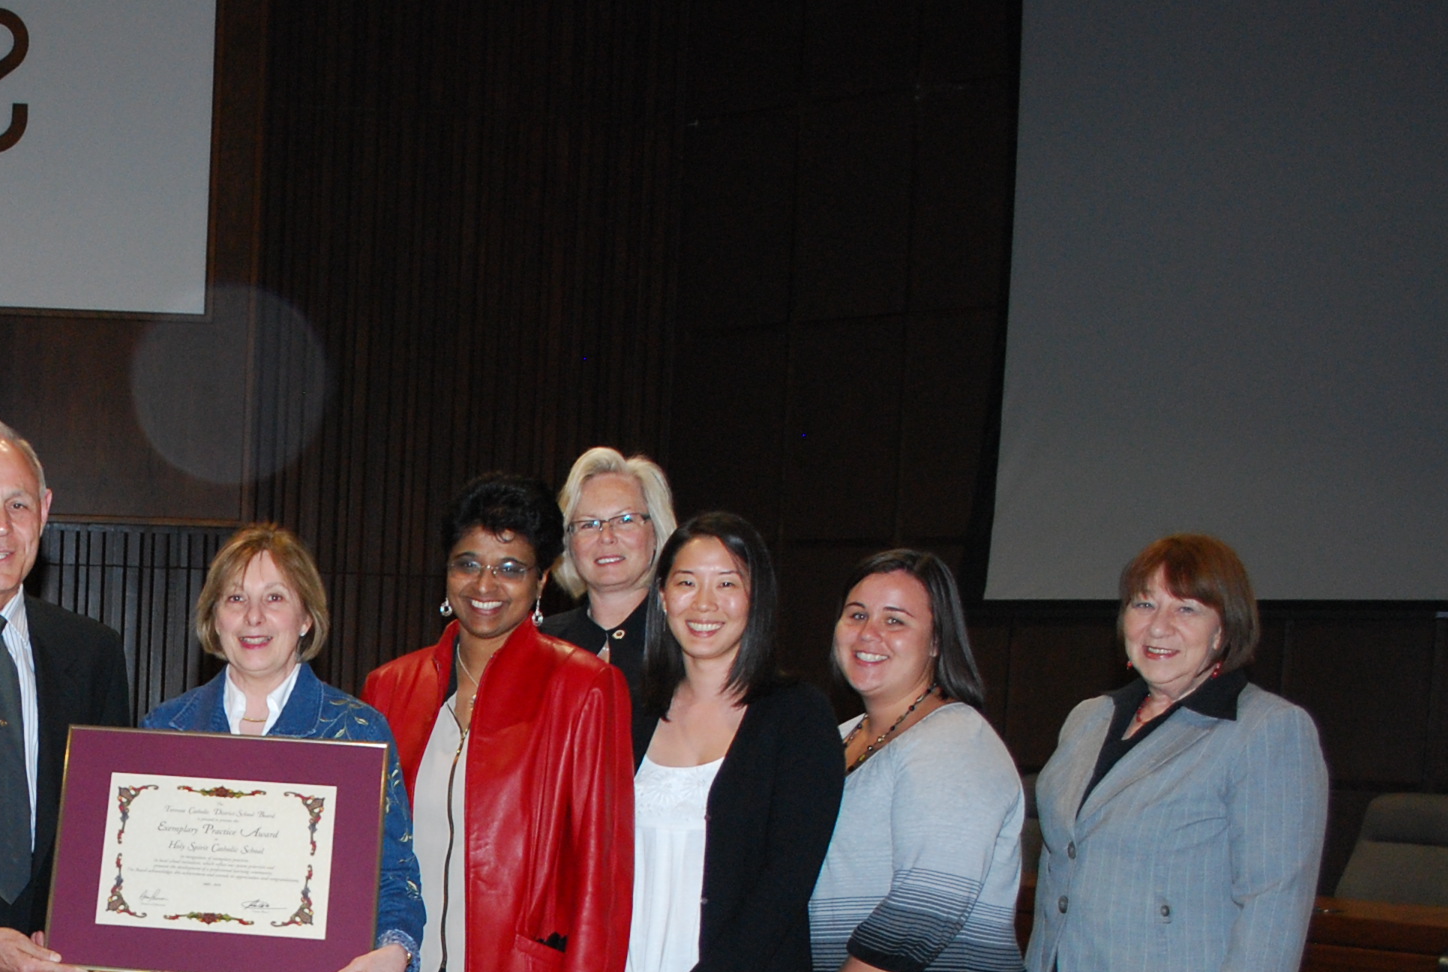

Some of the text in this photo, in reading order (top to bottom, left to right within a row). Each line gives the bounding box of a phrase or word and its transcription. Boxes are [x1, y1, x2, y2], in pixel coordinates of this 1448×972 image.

[157, 820, 199, 834] Exemplary
[202, 823, 237, 836] Practice
[240, 827, 280, 839] Award
[168, 840, 265, 855] Holy Spirit Catholic School
